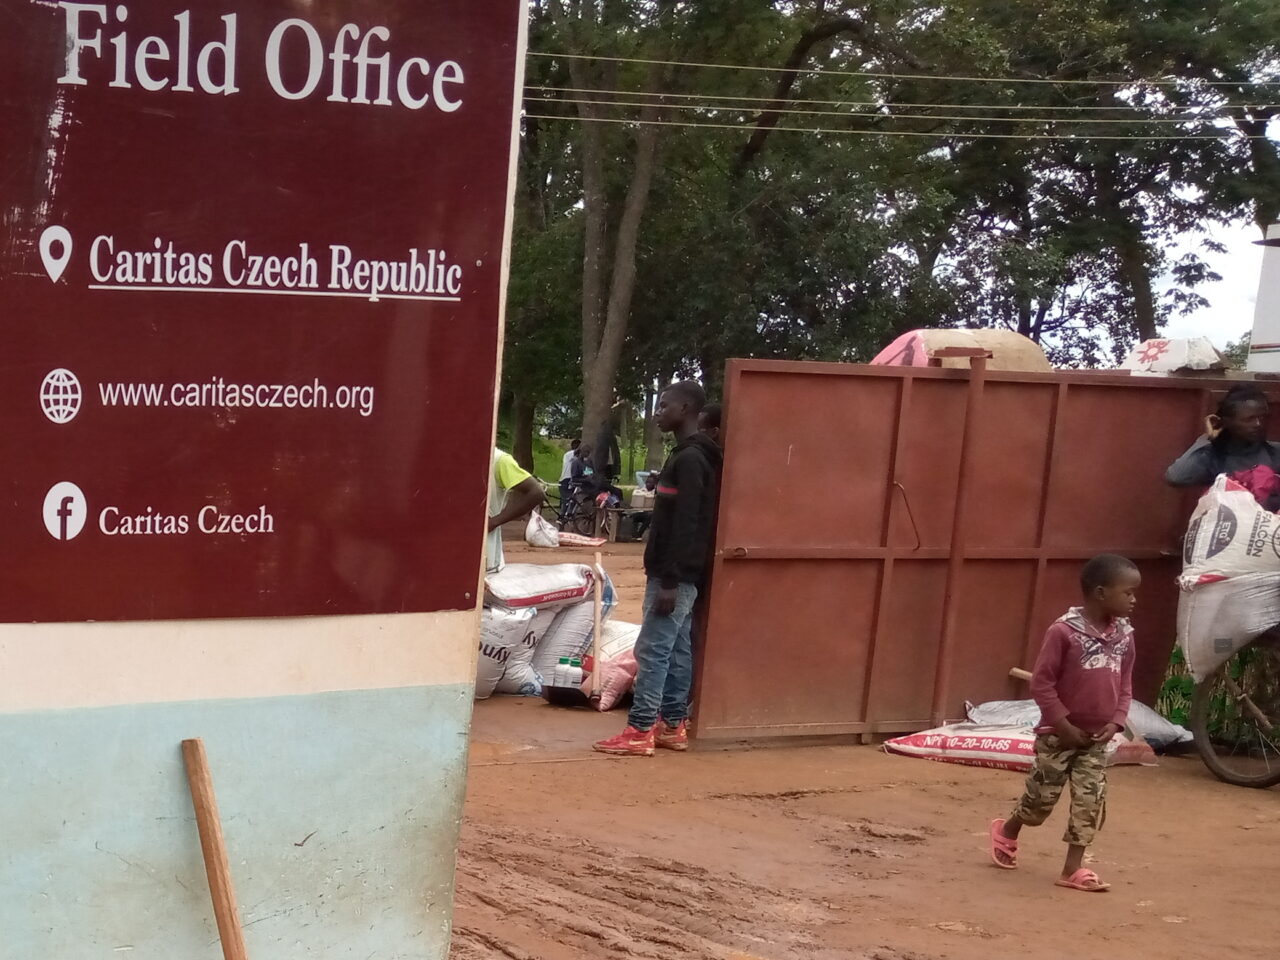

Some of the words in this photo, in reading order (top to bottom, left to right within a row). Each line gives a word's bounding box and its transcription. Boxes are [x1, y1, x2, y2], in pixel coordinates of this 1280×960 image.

[57, 0, 240, 96] Field
[265, 18, 465, 113] Office
[89, 234, 214, 286] Caritas
[222, 239, 320, 291] Czech
[327, 244, 462, 302] Republic
[98, 376, 375, 417] www.caritasczech.org
[98, 506, 189, 536] Caritas
[196, 504, 275, 536] Czech
[1017, 742, 1034, 751] 50K
